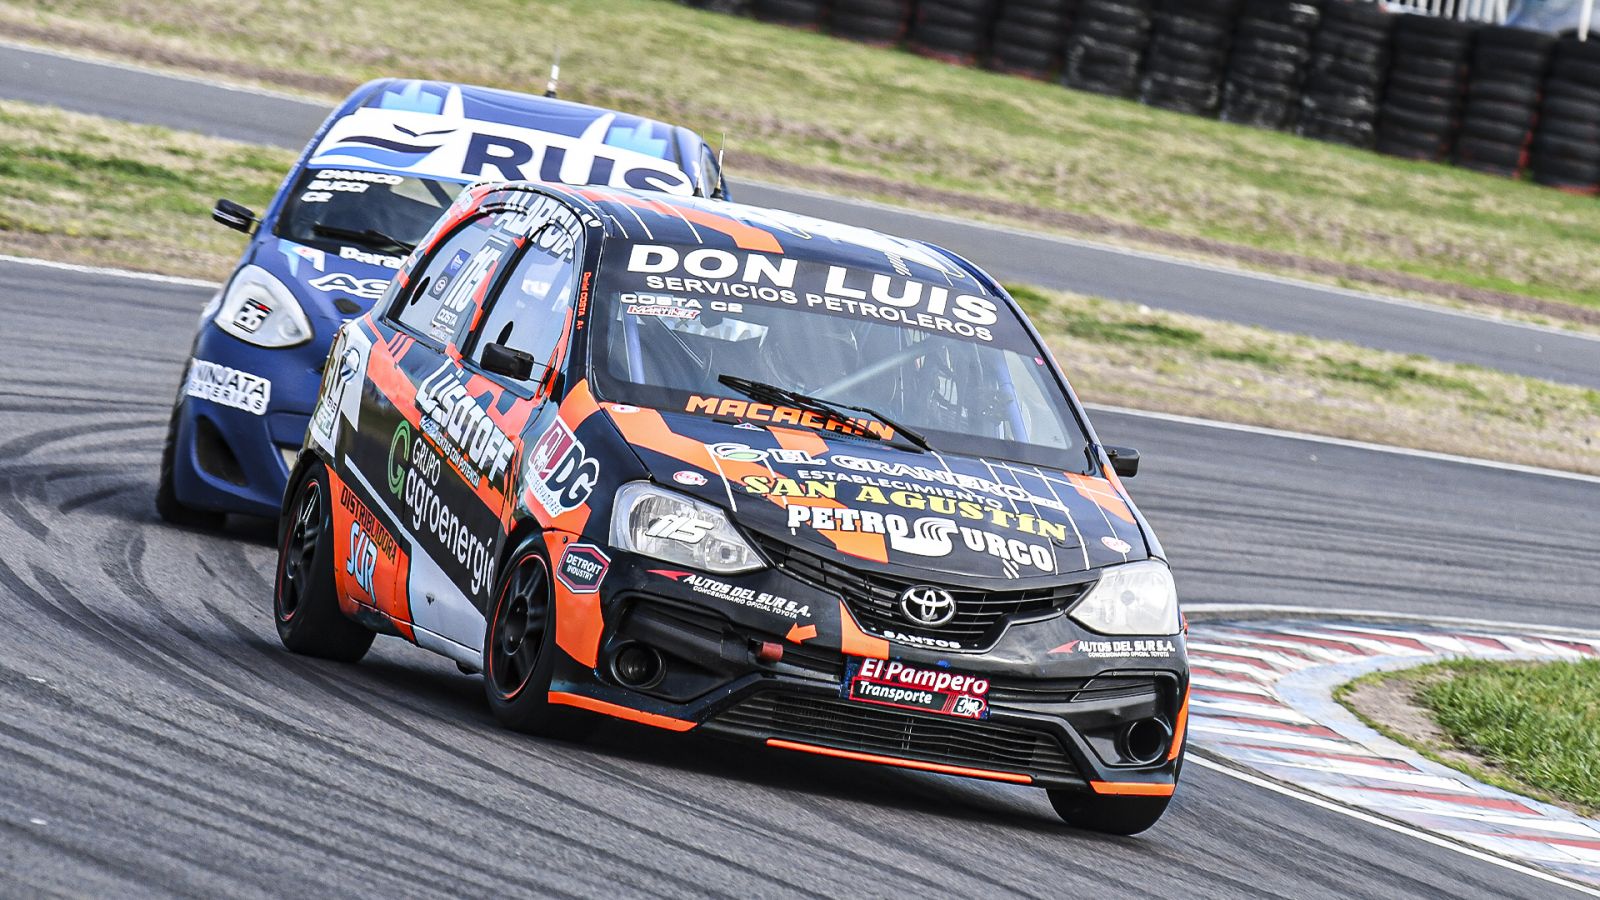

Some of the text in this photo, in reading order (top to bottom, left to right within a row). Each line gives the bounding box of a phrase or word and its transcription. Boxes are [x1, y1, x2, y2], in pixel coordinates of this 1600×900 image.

[627, 244, 997, 325] DON LUIS
[578, 292, 588, 317] COSTA
[620, 293, 743, 313] COSTA C2
[646, 275, 798, 304] SERVICIOS
[805, 293, 993, 341] PETROLEROS
[437, 308, 458, 327] COSTA
[412, 437, 440, 486] GRUPO
[769, 448, 826, 465] EL
[743, 475, 837, 498] SAN
[797, 469, 1003, 509] ESTABLECIMIENTO
[646, 515, 714, 544] 115
[346, 520, 378, 607] SUR
[566, 553, 603, 574] DETROIT
[566, 564, 593, 581] INDUSTRY
[683, 575, 812, 618] AUTOS DEL SUR S.A.
[693, 586, 798, 619] CONCESIONARIO OFICIAL TOYOTA
[883, 630, 961, 649] SANTOS
[1078, 641, 1111, 652] AUTOS
[1113, 641, 1133, 652] DEL
[1134, 641, 1156, 652] SUR
[860, 658, 988, 694] El Pampero
[860, 681, 932, 704] Transporte
